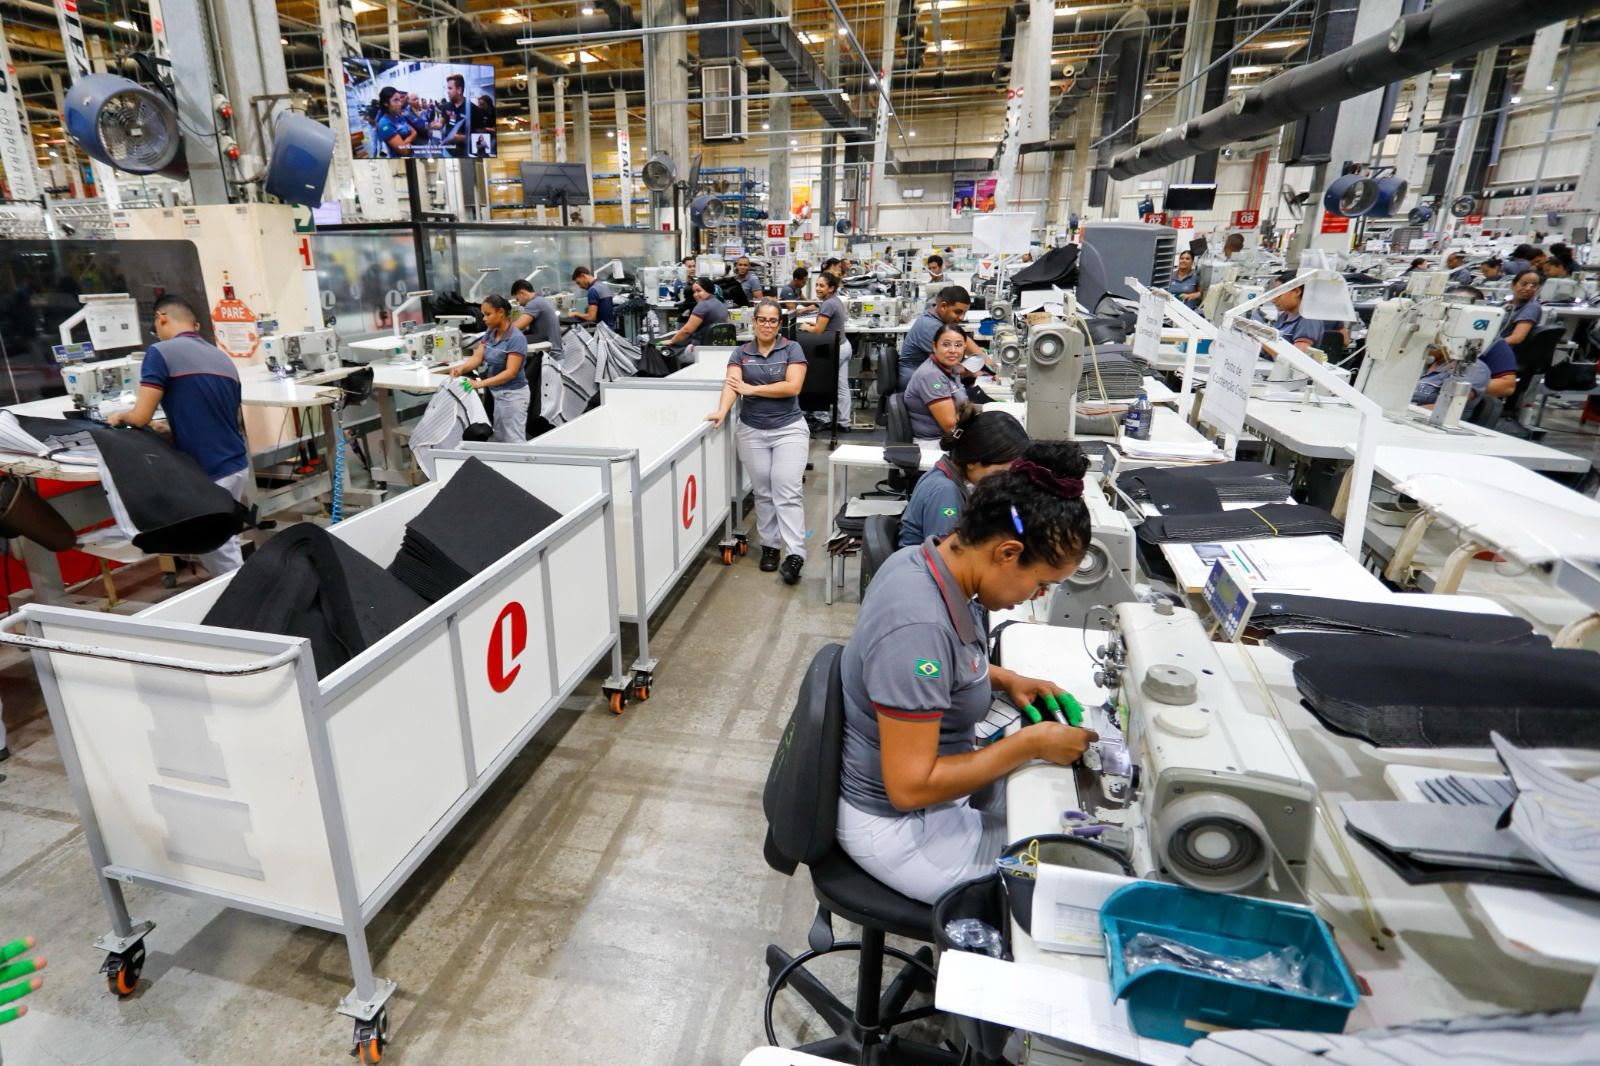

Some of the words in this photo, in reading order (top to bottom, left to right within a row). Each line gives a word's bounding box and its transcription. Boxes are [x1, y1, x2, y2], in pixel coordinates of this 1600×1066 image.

[64, 13, 91, 76] LEA
[338, 0, 363, 58] LEA
[771, 228, 782, 236] 01
[220, 306, 246, 320] PARE
